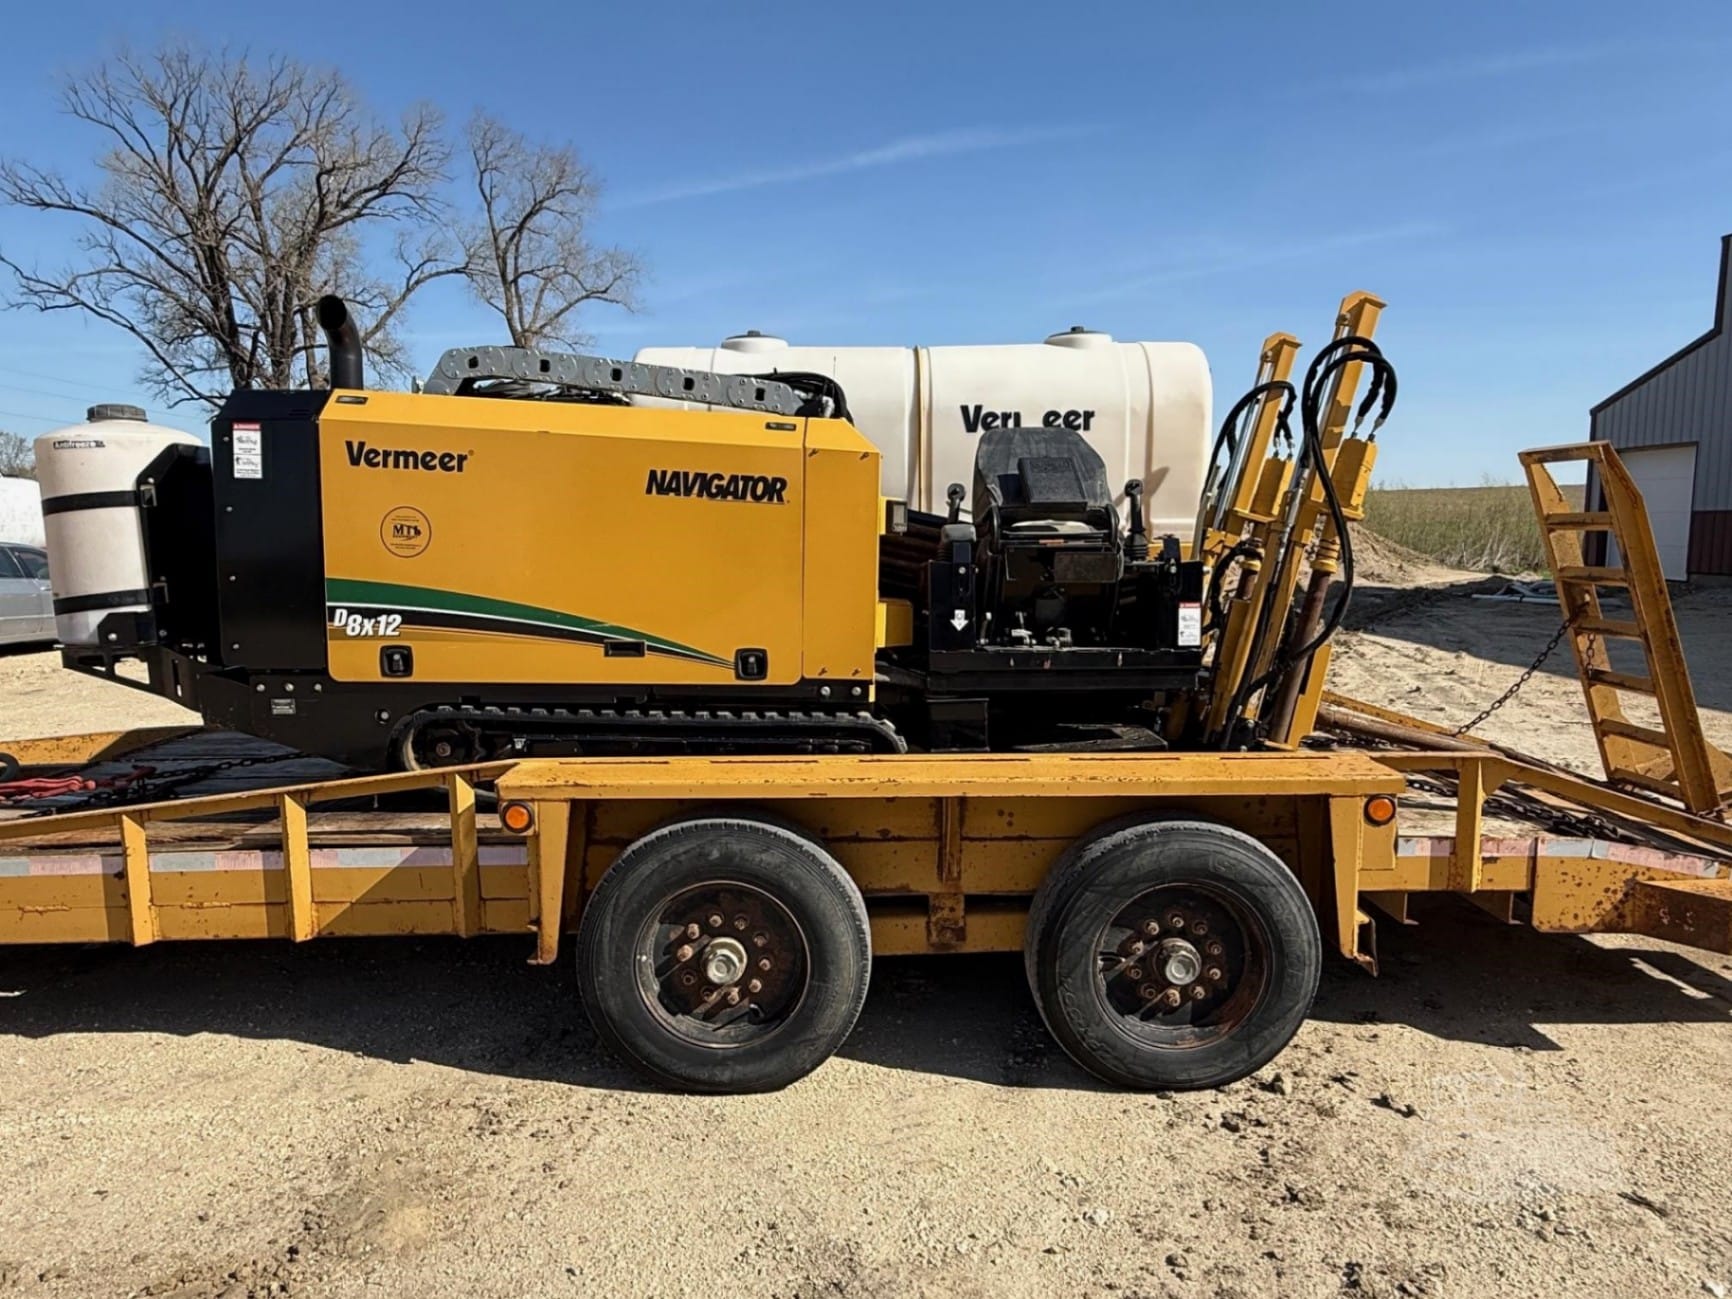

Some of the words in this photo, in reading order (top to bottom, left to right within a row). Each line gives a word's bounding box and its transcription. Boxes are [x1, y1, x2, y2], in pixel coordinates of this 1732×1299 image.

[345, 440, 469, 473] Vermeer
[645, 469, 788, 503] NAVIGATOR
[333, 608, 402, 636] D8x12
